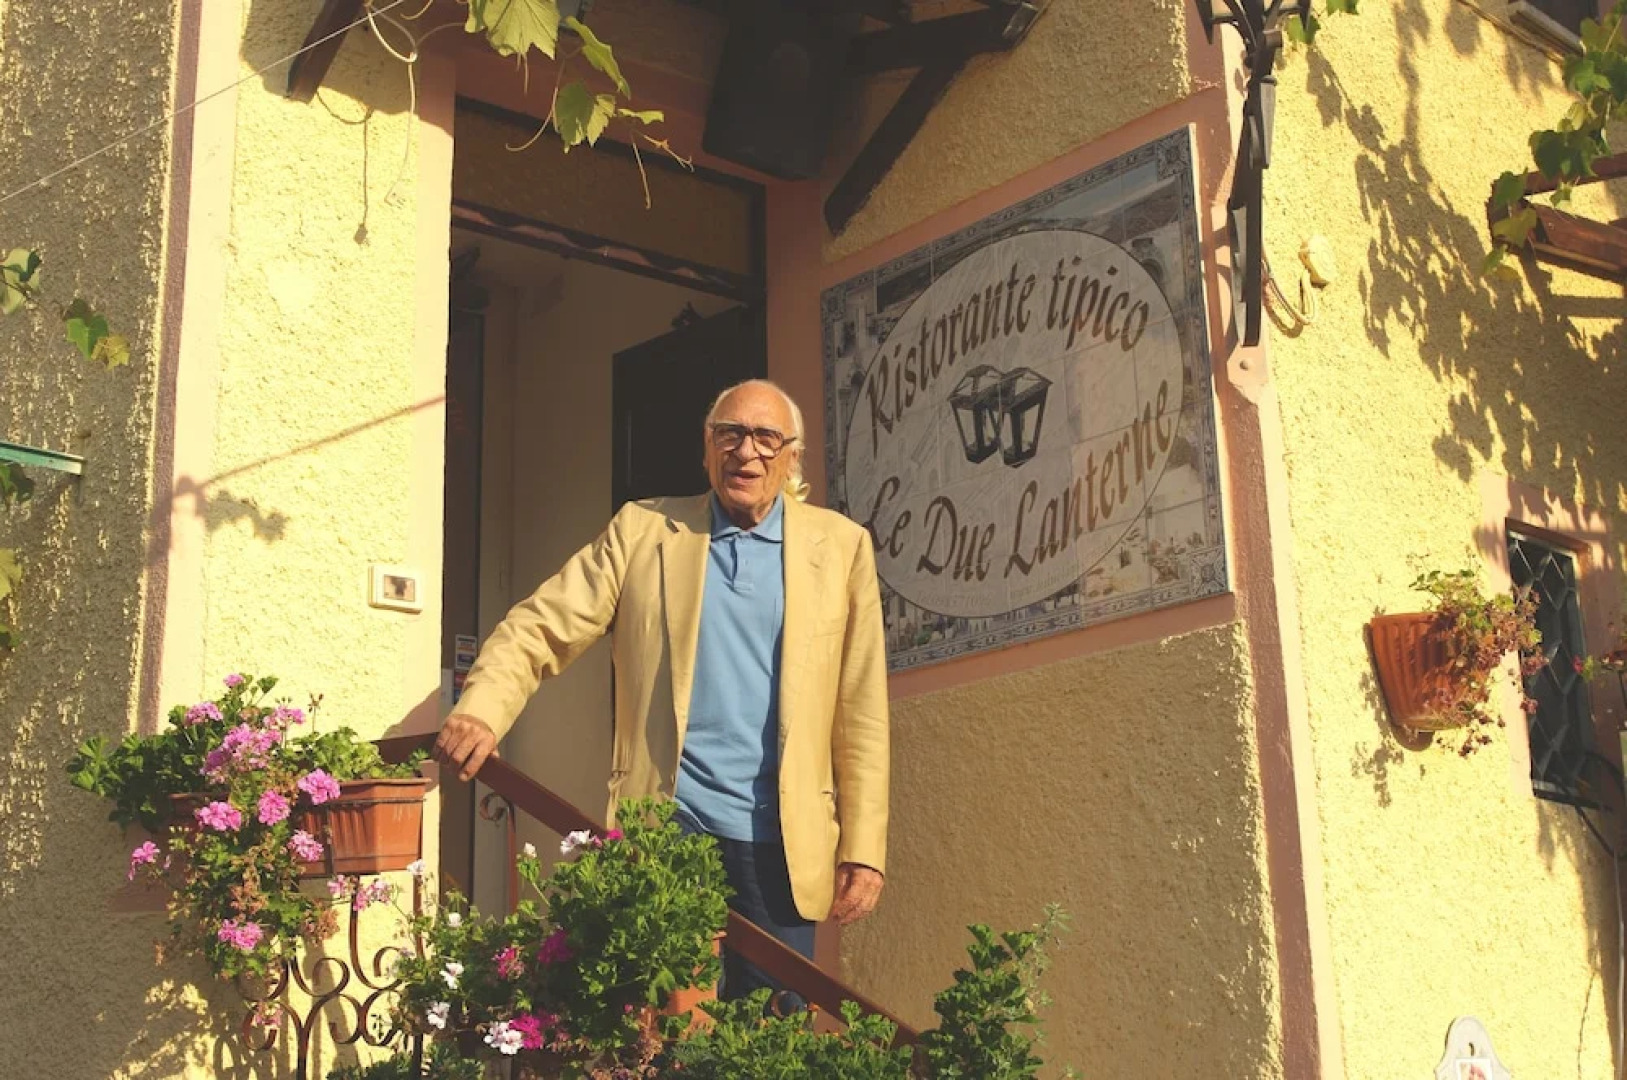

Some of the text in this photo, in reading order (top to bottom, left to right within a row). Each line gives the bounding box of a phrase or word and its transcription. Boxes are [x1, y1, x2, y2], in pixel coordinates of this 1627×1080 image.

[866, 256, 1149, 460] Ristorante tipico
[864, 379, 1171, 582] Le Due Lanterne
